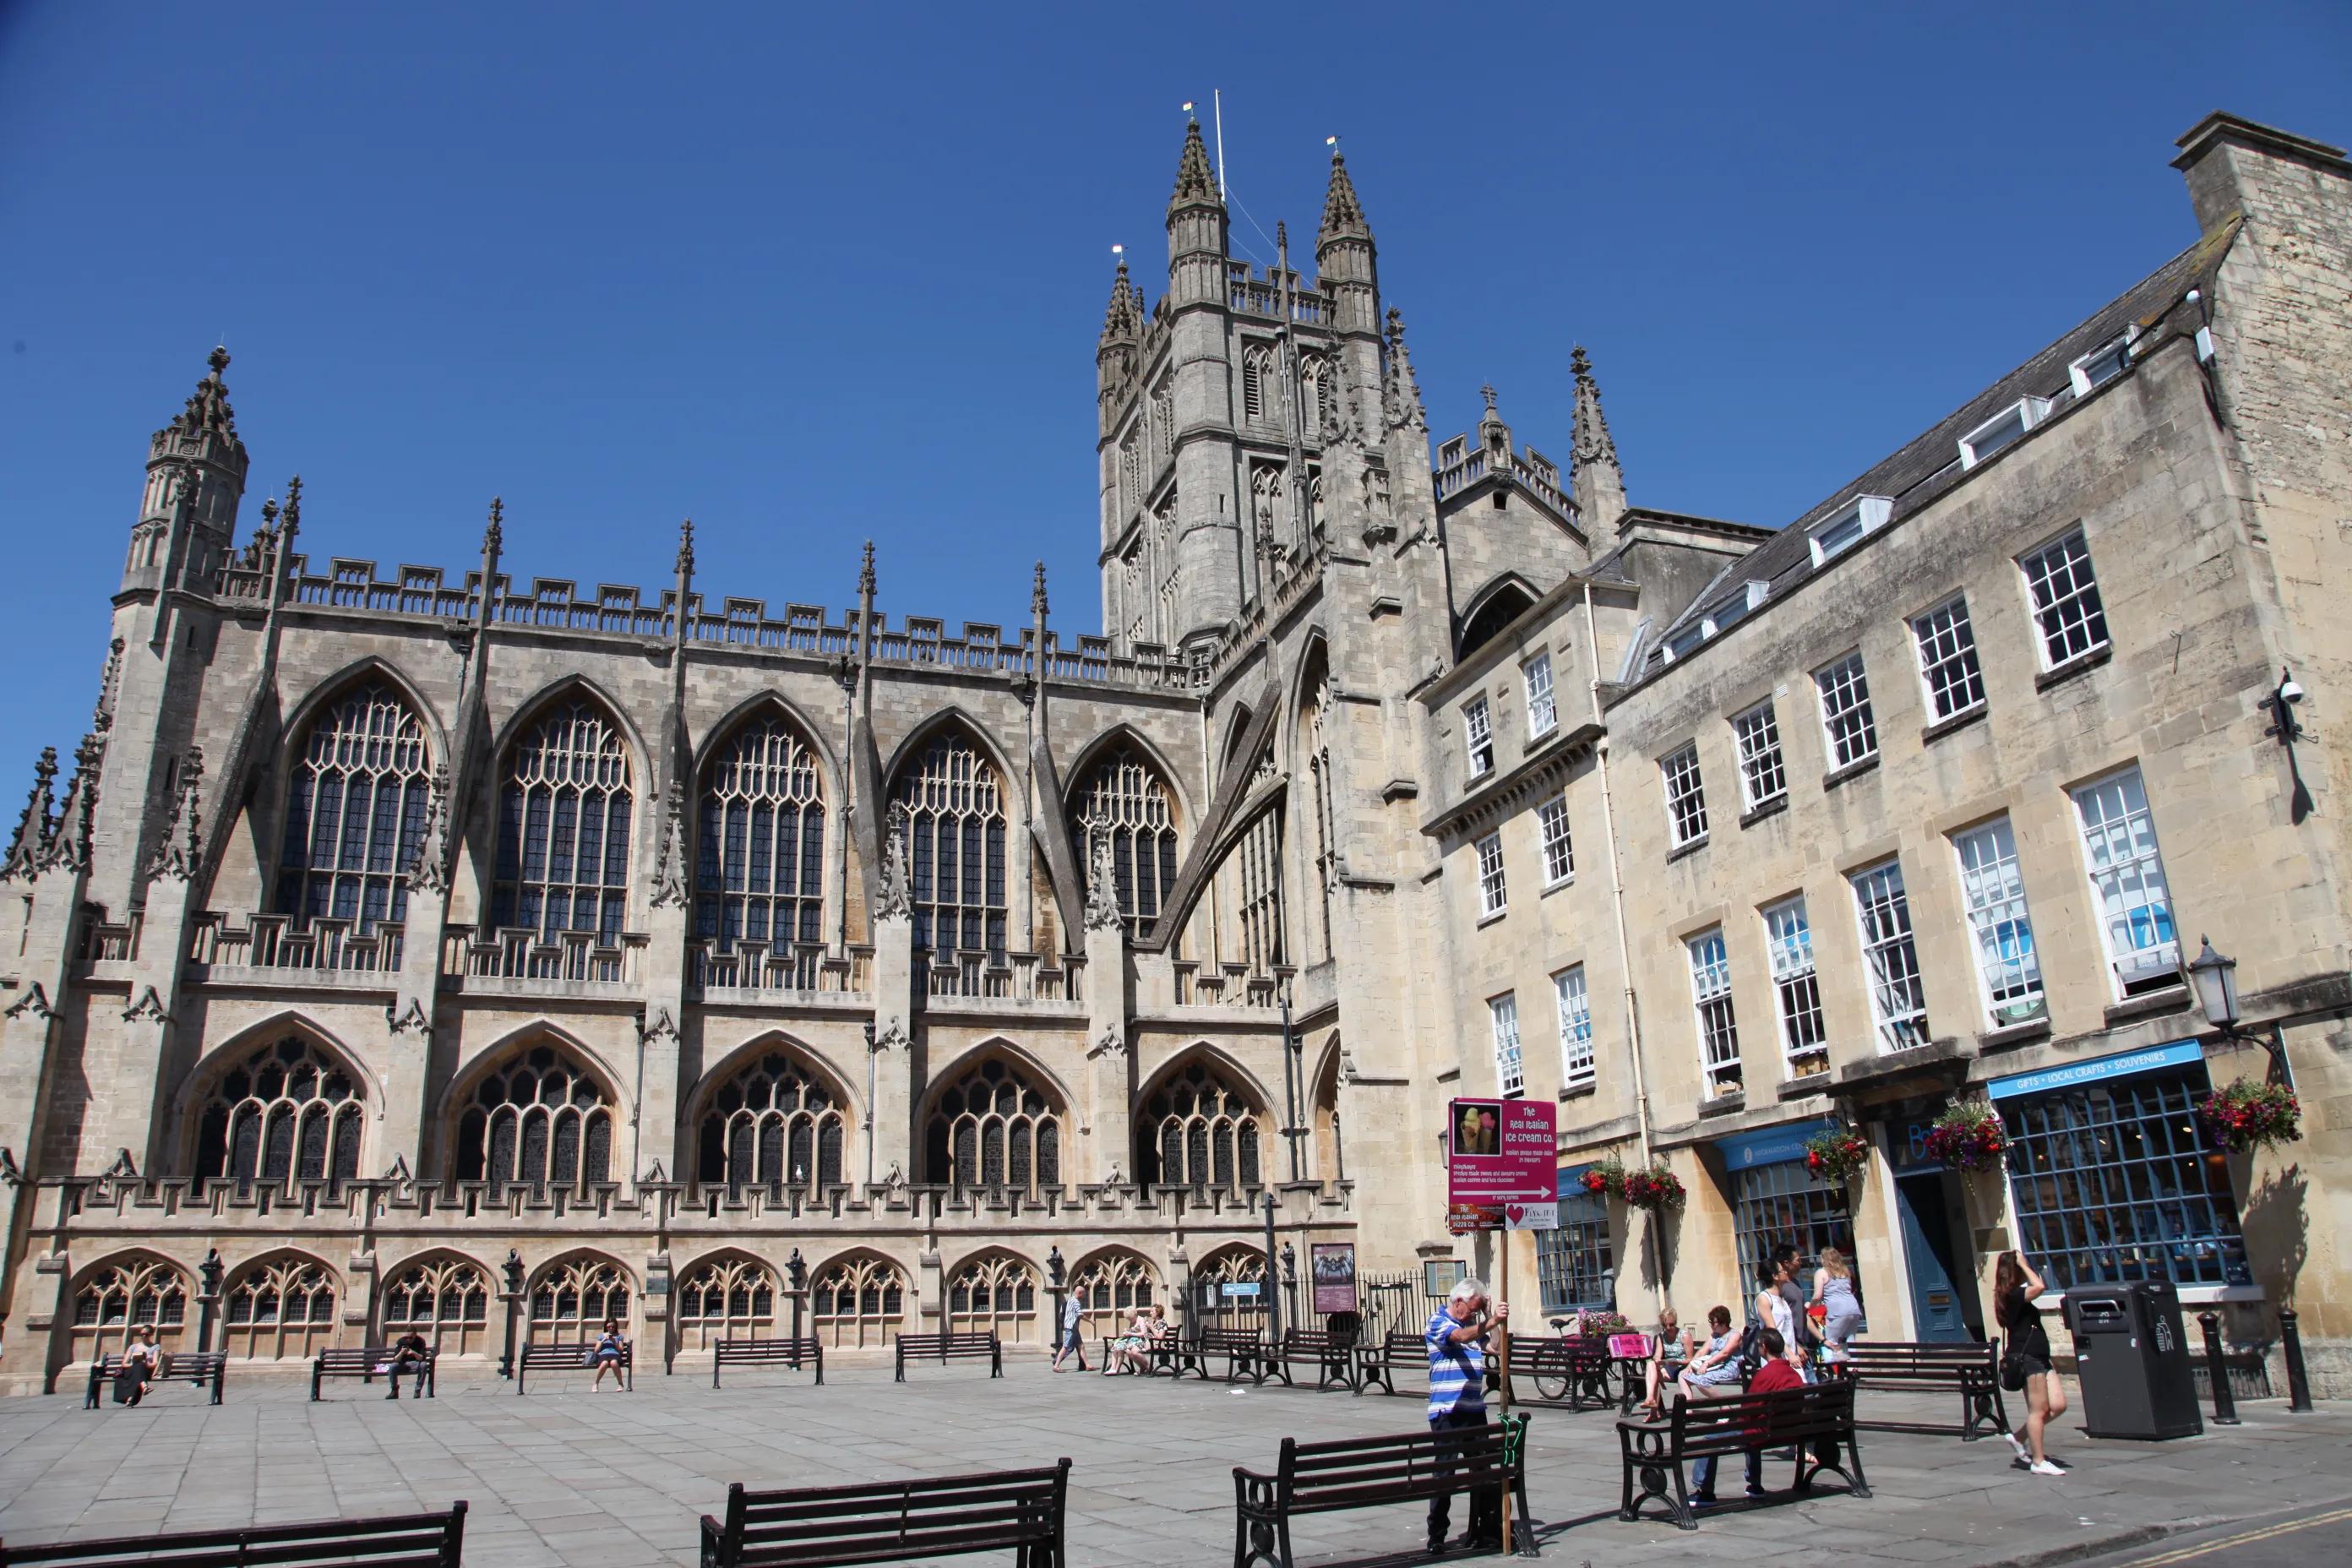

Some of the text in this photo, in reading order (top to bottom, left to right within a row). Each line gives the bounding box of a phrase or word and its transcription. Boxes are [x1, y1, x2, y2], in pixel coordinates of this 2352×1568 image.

[2017, 1051, 2166, 1089] GIFTS LOCAL CRAFTS SOUVENIRS
[1523, 1106, 1536, 1117] The
[1510, 1119, 1549, 1130] Real Italian
[1505, 1133, 1516, 1142] Ice
[1517, 1133, 1542, 1143] Cream
